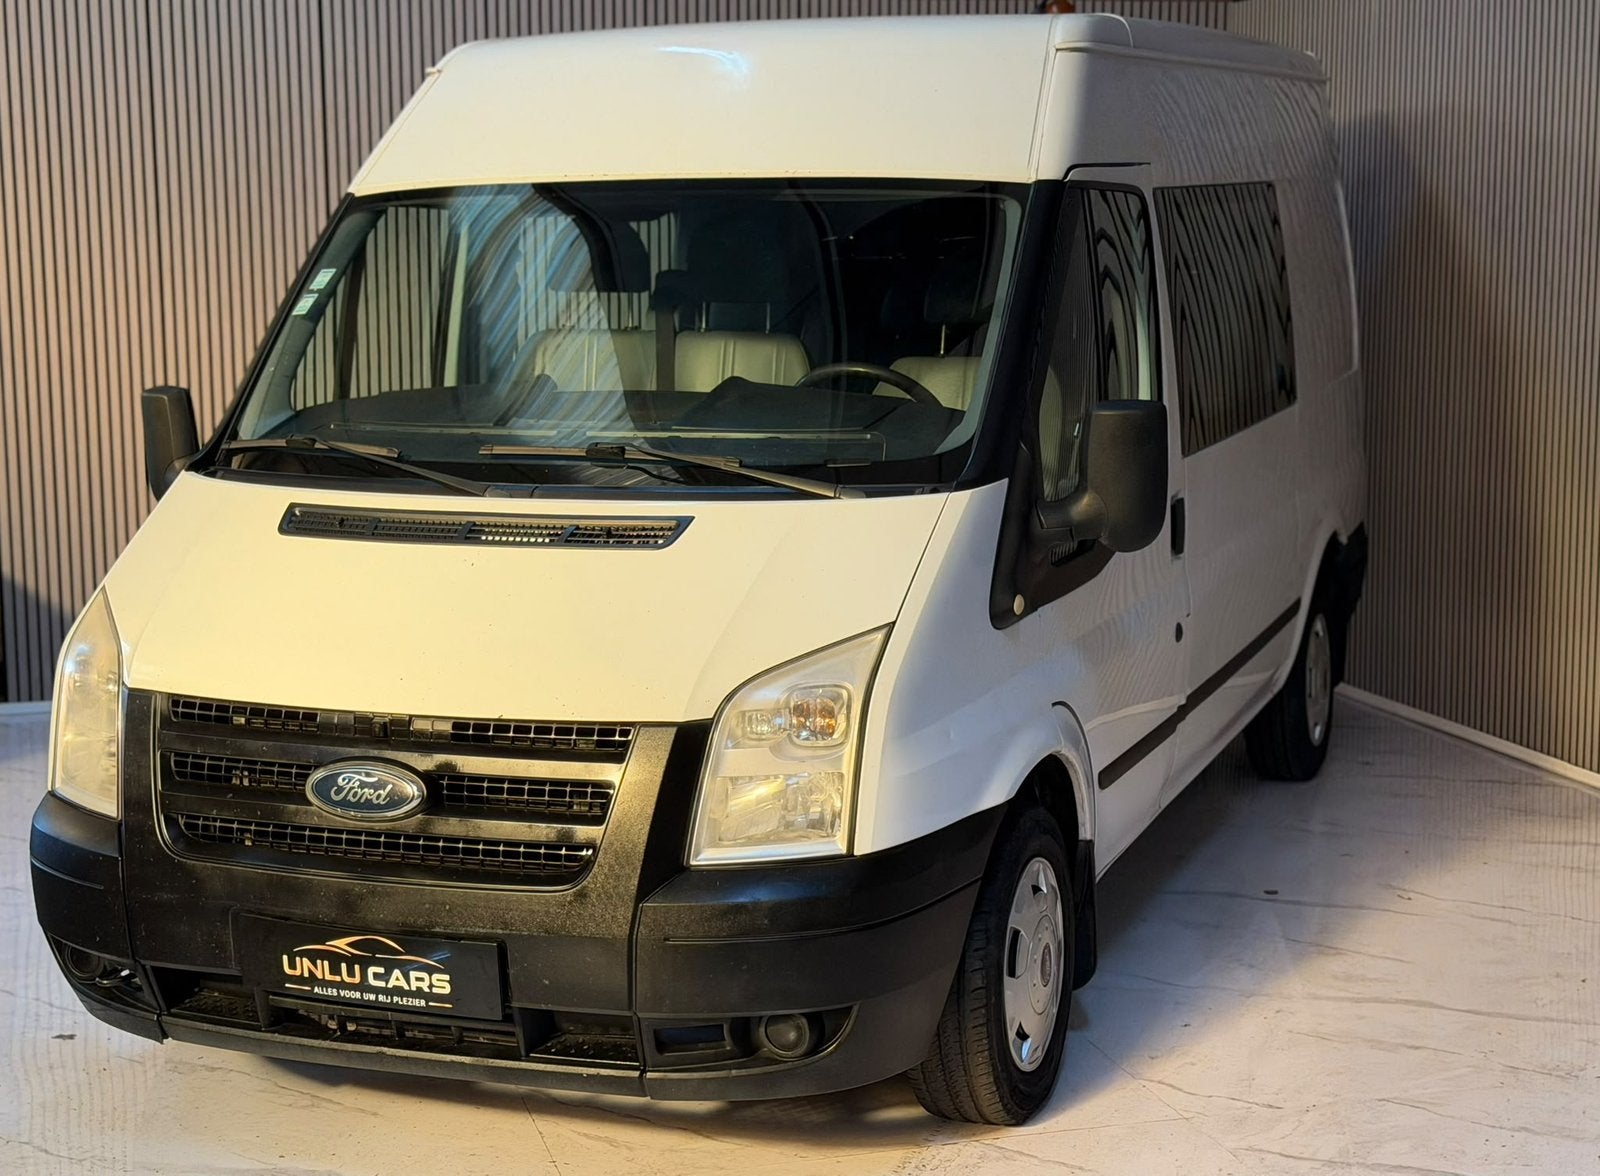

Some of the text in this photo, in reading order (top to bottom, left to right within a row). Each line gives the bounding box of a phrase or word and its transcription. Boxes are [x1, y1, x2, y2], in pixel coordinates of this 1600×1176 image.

[330, 773, 393, 805] Ford
[282, 954, 451, 995] UNLU CARS
[313, 985, 426, 1007] ALLES VOOR UW RIJ PLEZIER
